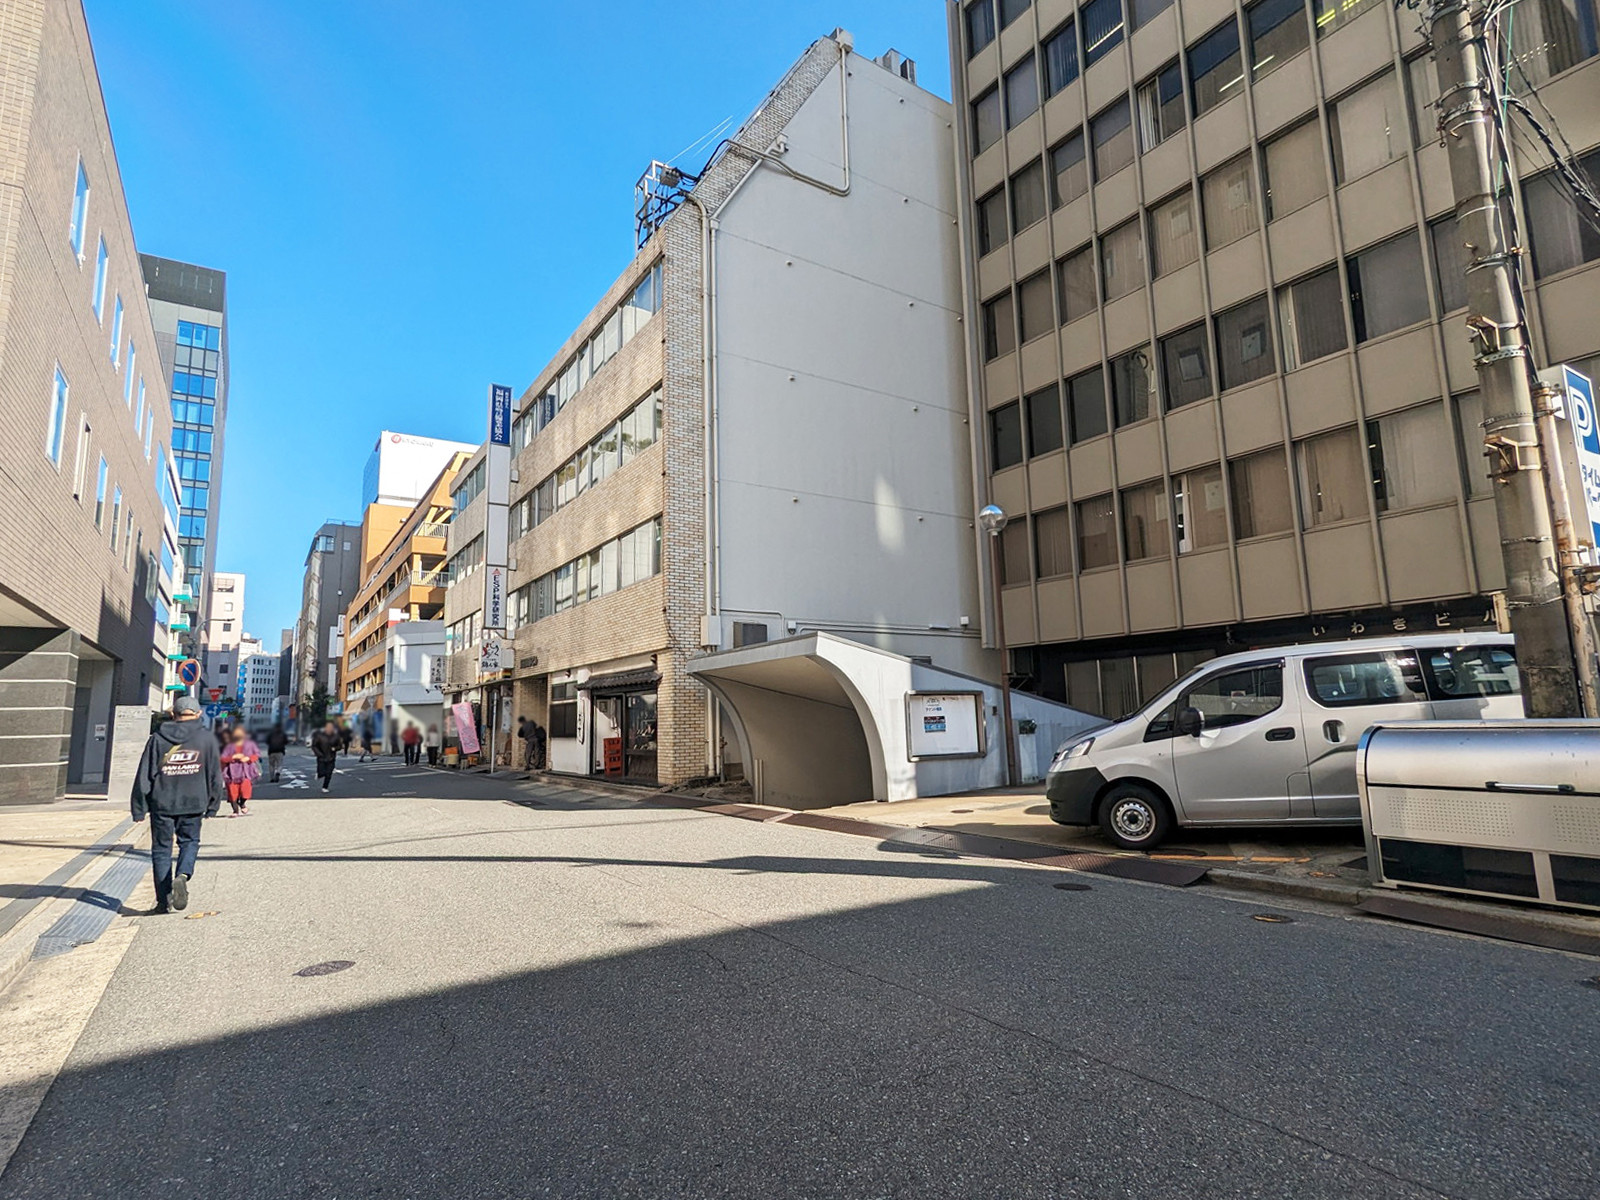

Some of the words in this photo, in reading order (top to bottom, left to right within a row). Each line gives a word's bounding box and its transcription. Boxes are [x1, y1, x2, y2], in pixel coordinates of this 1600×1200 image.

[492, 575, 501, 626] ESP科学研究所
[1312, 609, 1497, 637] いわきビル
